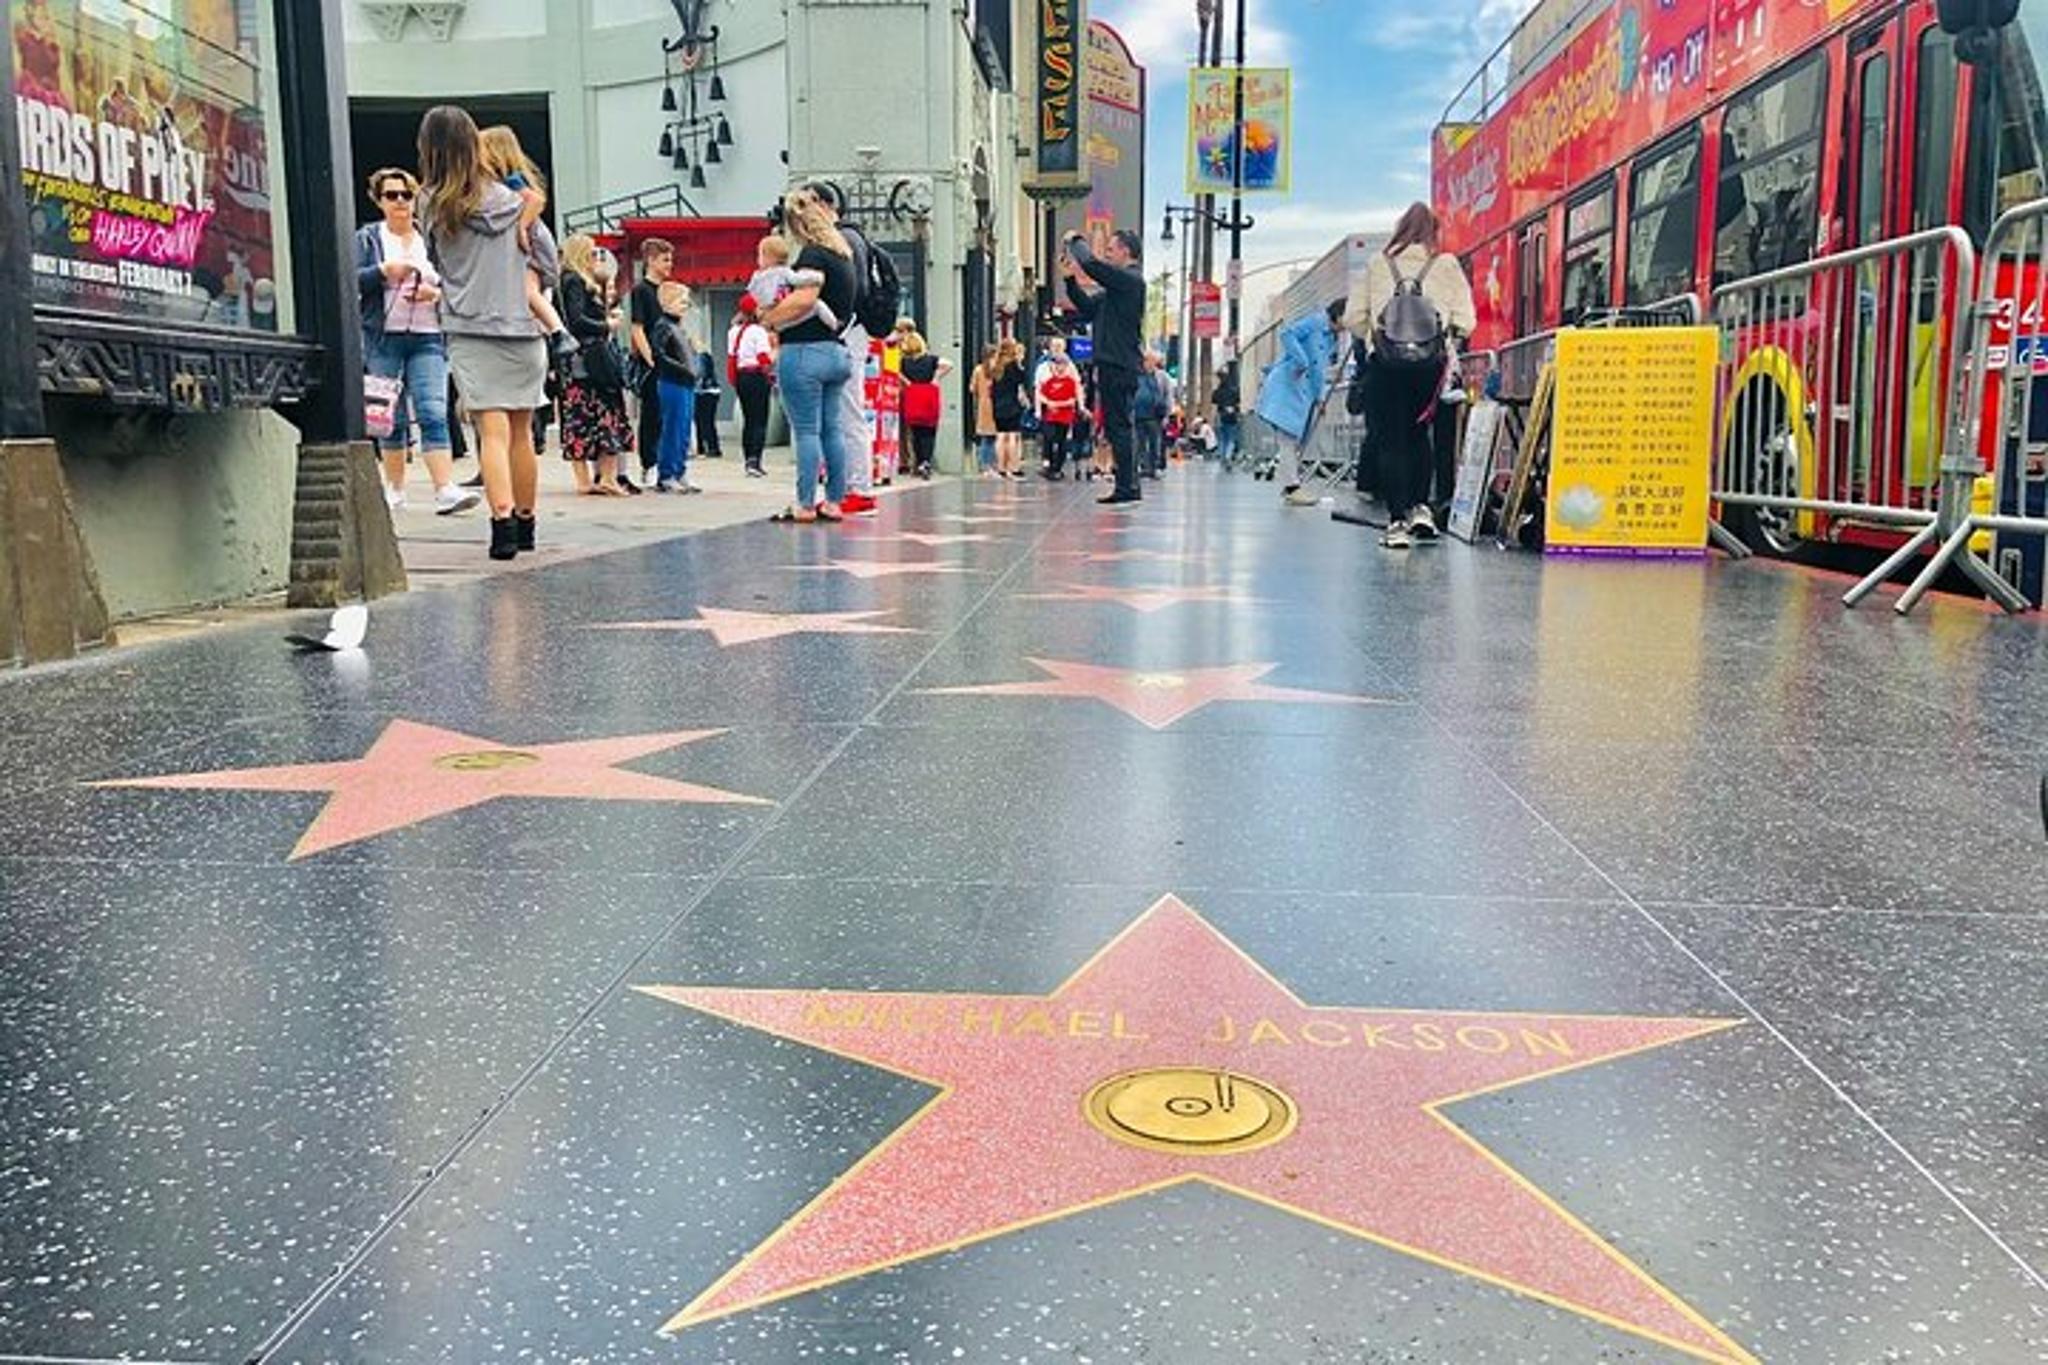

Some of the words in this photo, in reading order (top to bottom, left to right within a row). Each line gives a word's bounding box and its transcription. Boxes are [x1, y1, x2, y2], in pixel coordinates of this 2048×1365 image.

[15, 95, 94, 183] IRDS
[100, 121, 137, 194] OF
[804, 1001, 1151, 1040] MICHAEL
[1210, 1014, 1574, 1057] JACKSON
